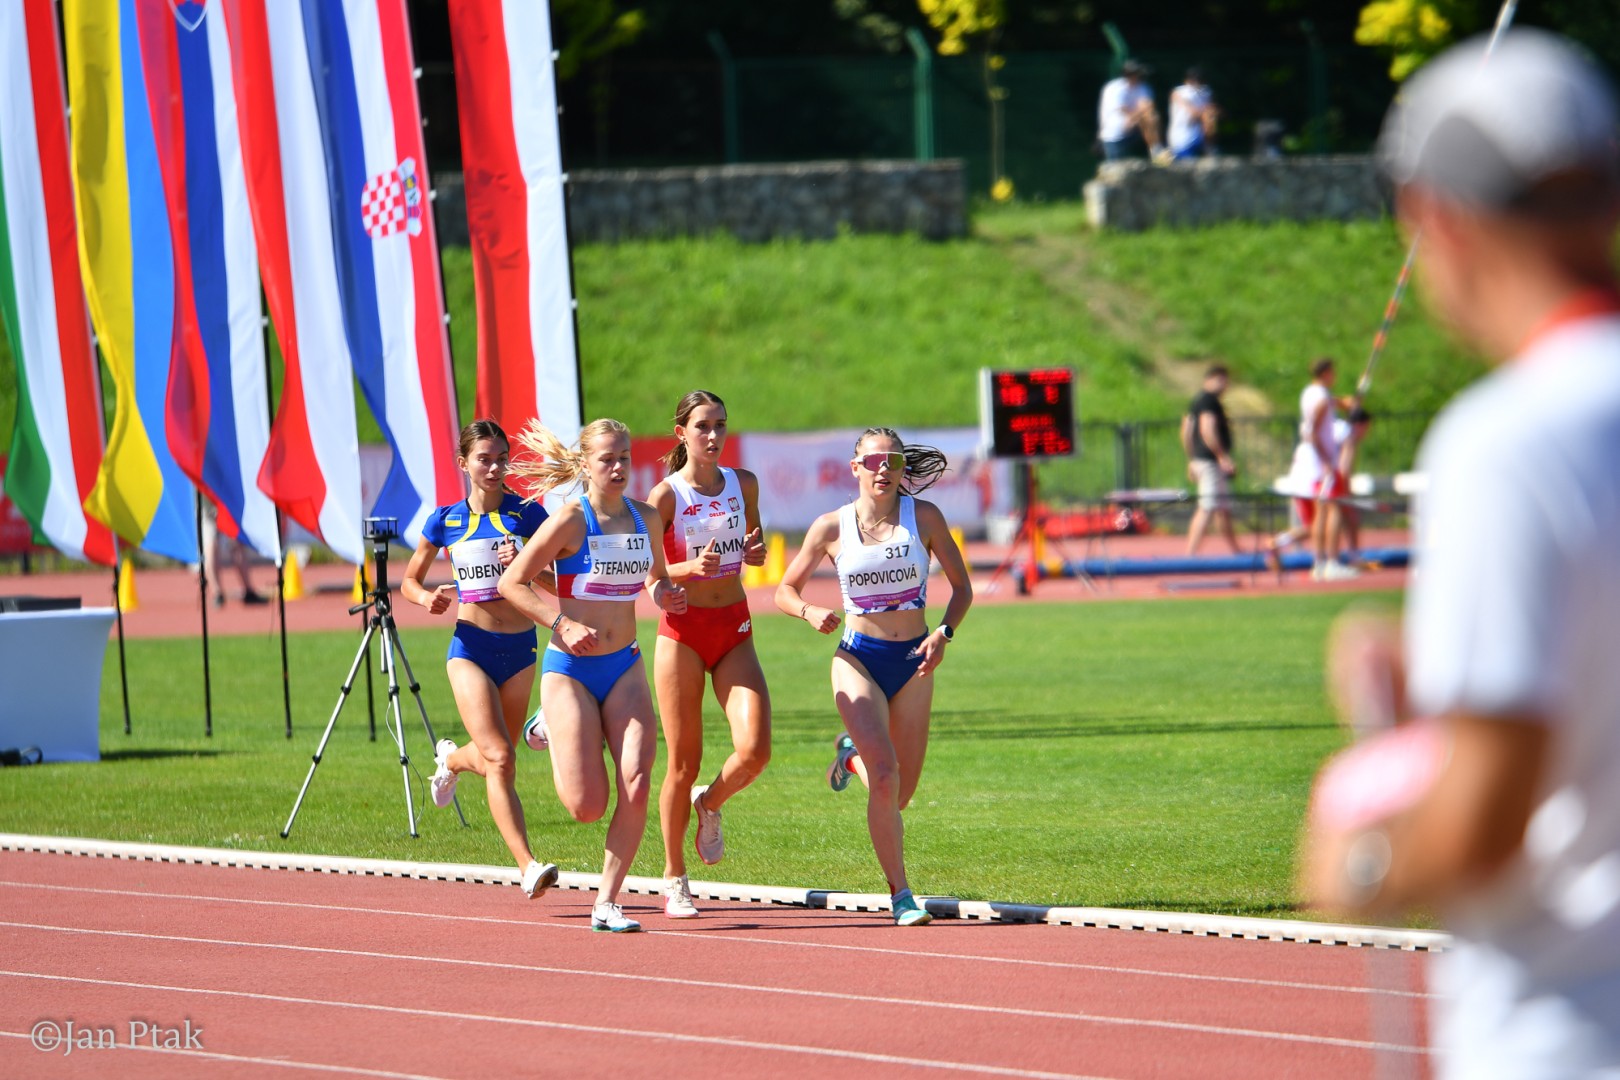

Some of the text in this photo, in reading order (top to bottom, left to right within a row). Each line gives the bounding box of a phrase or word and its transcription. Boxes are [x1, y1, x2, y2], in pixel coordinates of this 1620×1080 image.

[727, 515, 739, 529] 17
[627, 538, 645, 550] 117
[693, 537, 745, 558] TAMM
[885, 544, 910, 560] 317
[593, 557, 650, 575] ŠTEFANOVÁ
[848, 563, 918, 588] POPOVICOVÁ
